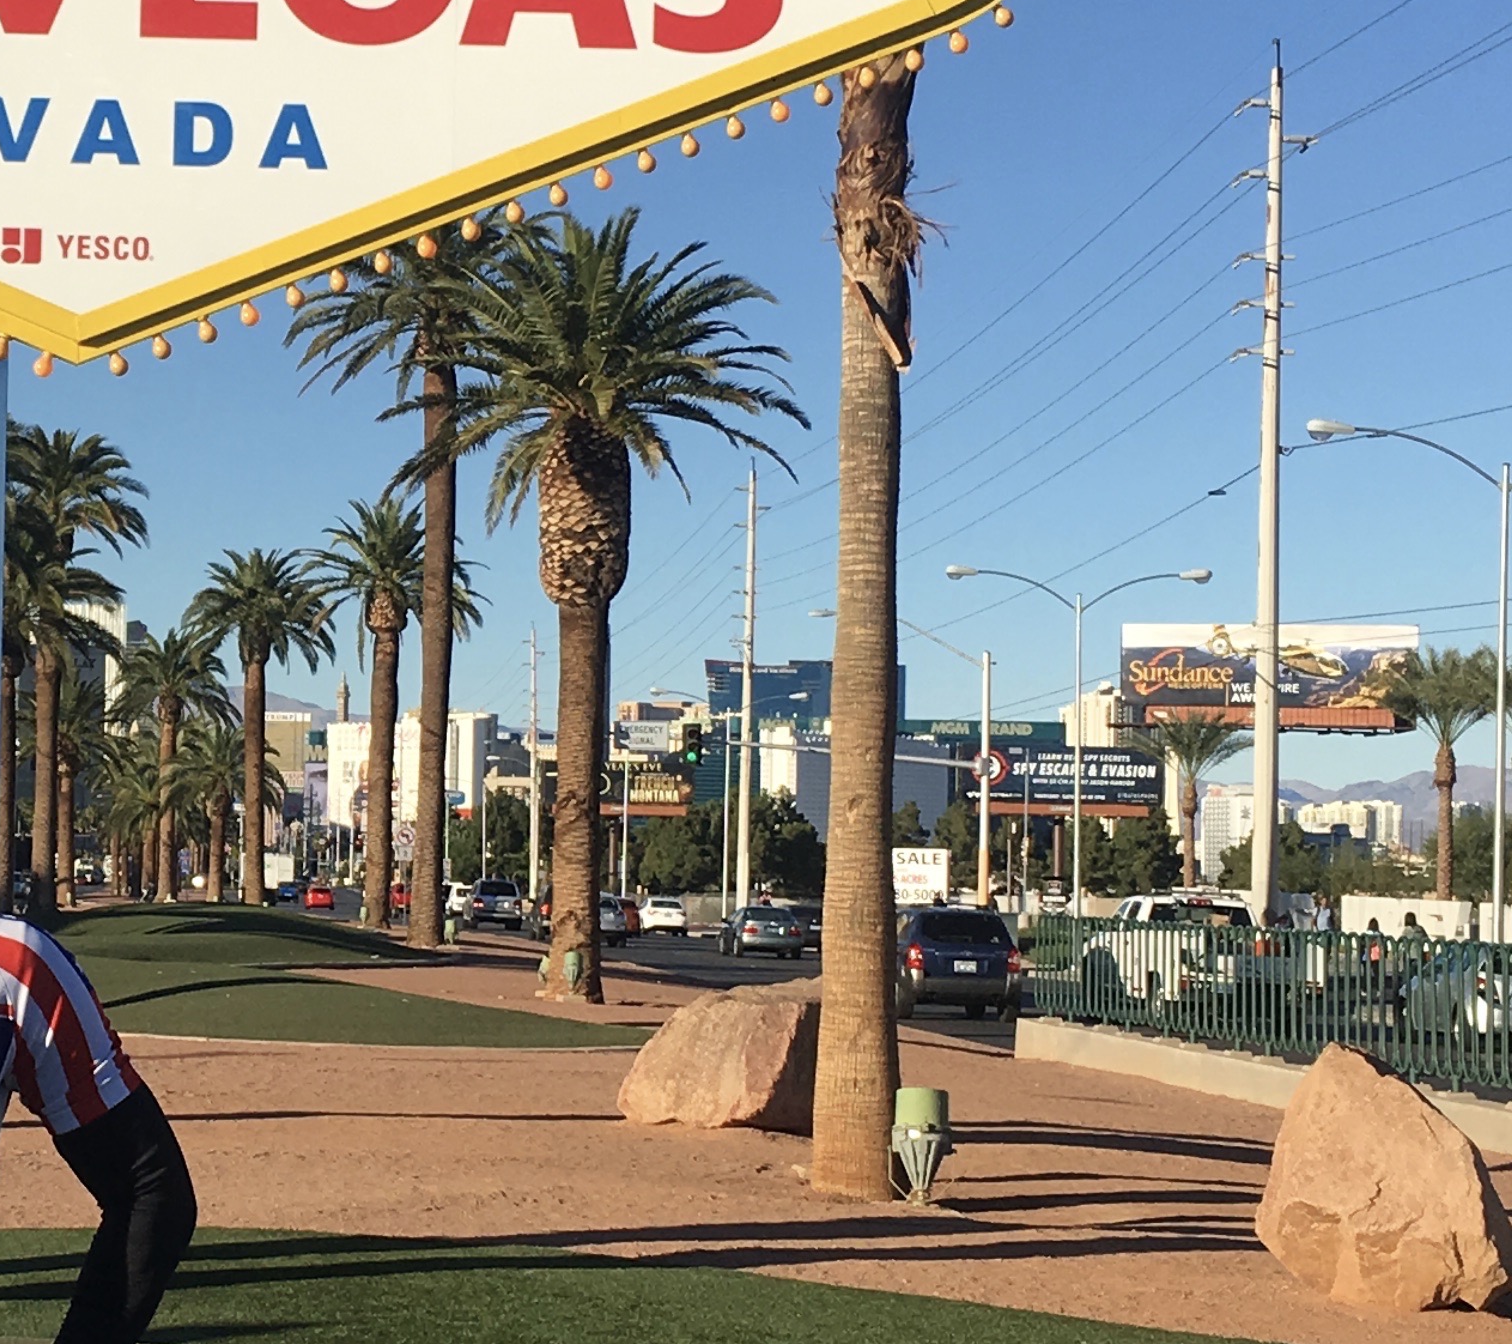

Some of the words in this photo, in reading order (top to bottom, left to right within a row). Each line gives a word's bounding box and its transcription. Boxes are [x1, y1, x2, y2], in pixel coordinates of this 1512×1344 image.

[56, 234, 150, 261] YESCO
[1129, 654, 1233, 683] Sundance
[1231, 683, 1251, 694] WE
[931, 721, 970, 735] MGM
[1088, 764, 1098, 776] &
[1100, 764, 1157, 778] EVASION
[630, 789, 679, 804] MONTANA
[897, 852, 942, 865] SALE
